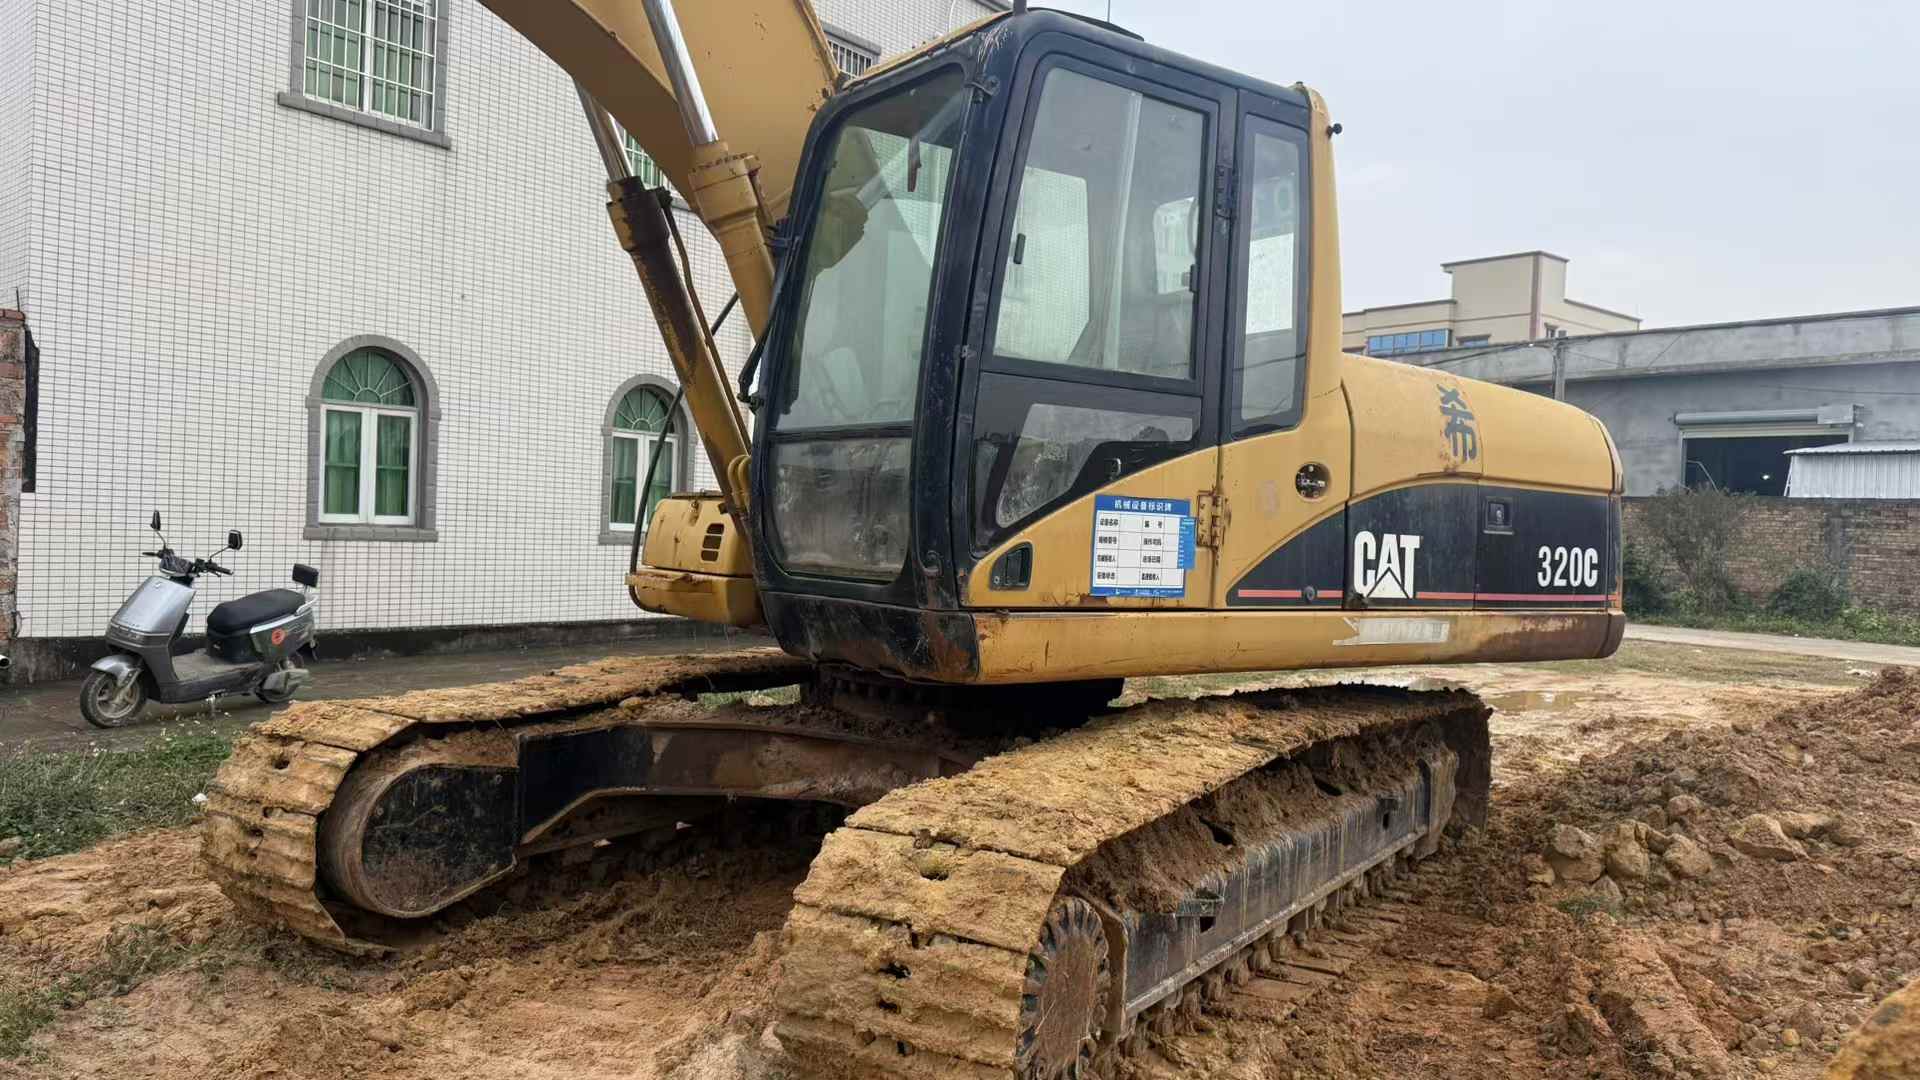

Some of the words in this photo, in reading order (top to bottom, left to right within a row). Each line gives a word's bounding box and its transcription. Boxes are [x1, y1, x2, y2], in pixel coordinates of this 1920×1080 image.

[1114, 499, 1172, 512] 机械设备标识牌
[1353, 530, 1421, 599] CAT
[1537, 545, 1599, 588] 320C
